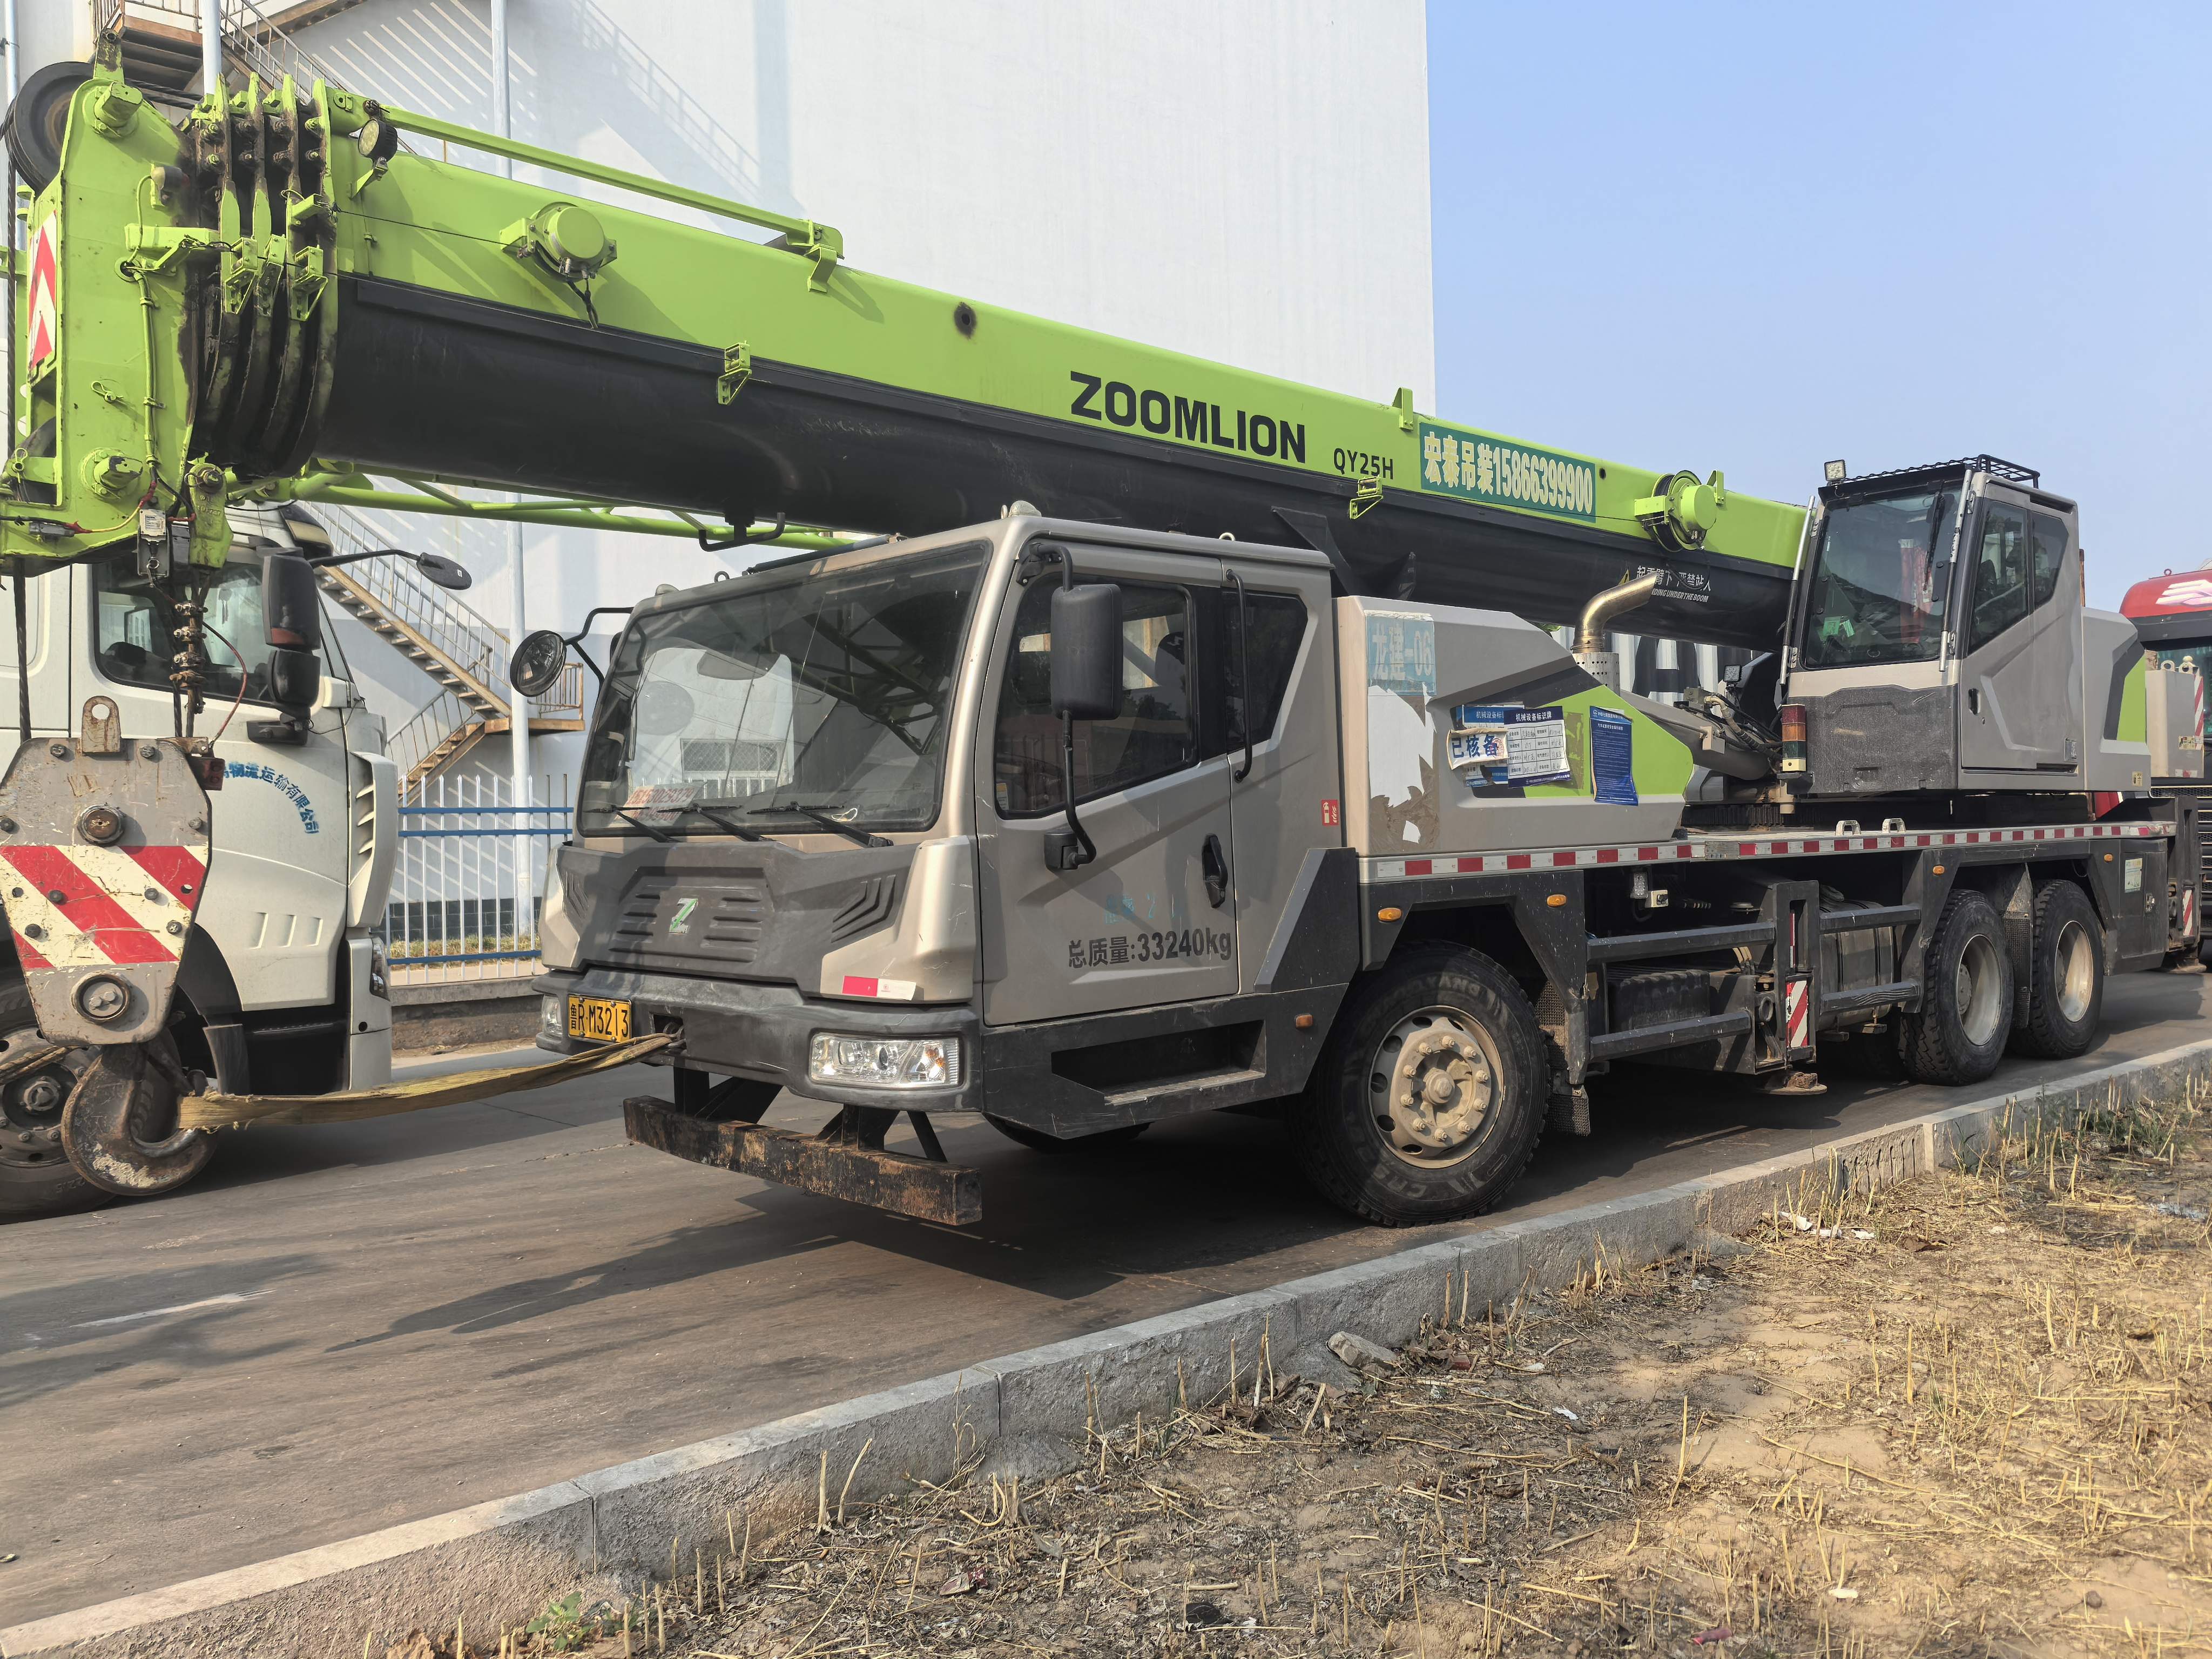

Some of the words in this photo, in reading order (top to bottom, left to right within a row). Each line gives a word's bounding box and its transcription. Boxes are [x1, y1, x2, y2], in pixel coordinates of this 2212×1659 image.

[1070, 370, 1306, 463] ZOOMLION
[1333, 448, 1394, 480] QY25H
[1516, 711, 1552, 722] 机械设备标识牌
[1451, 734, 1498, 758] 已核备
